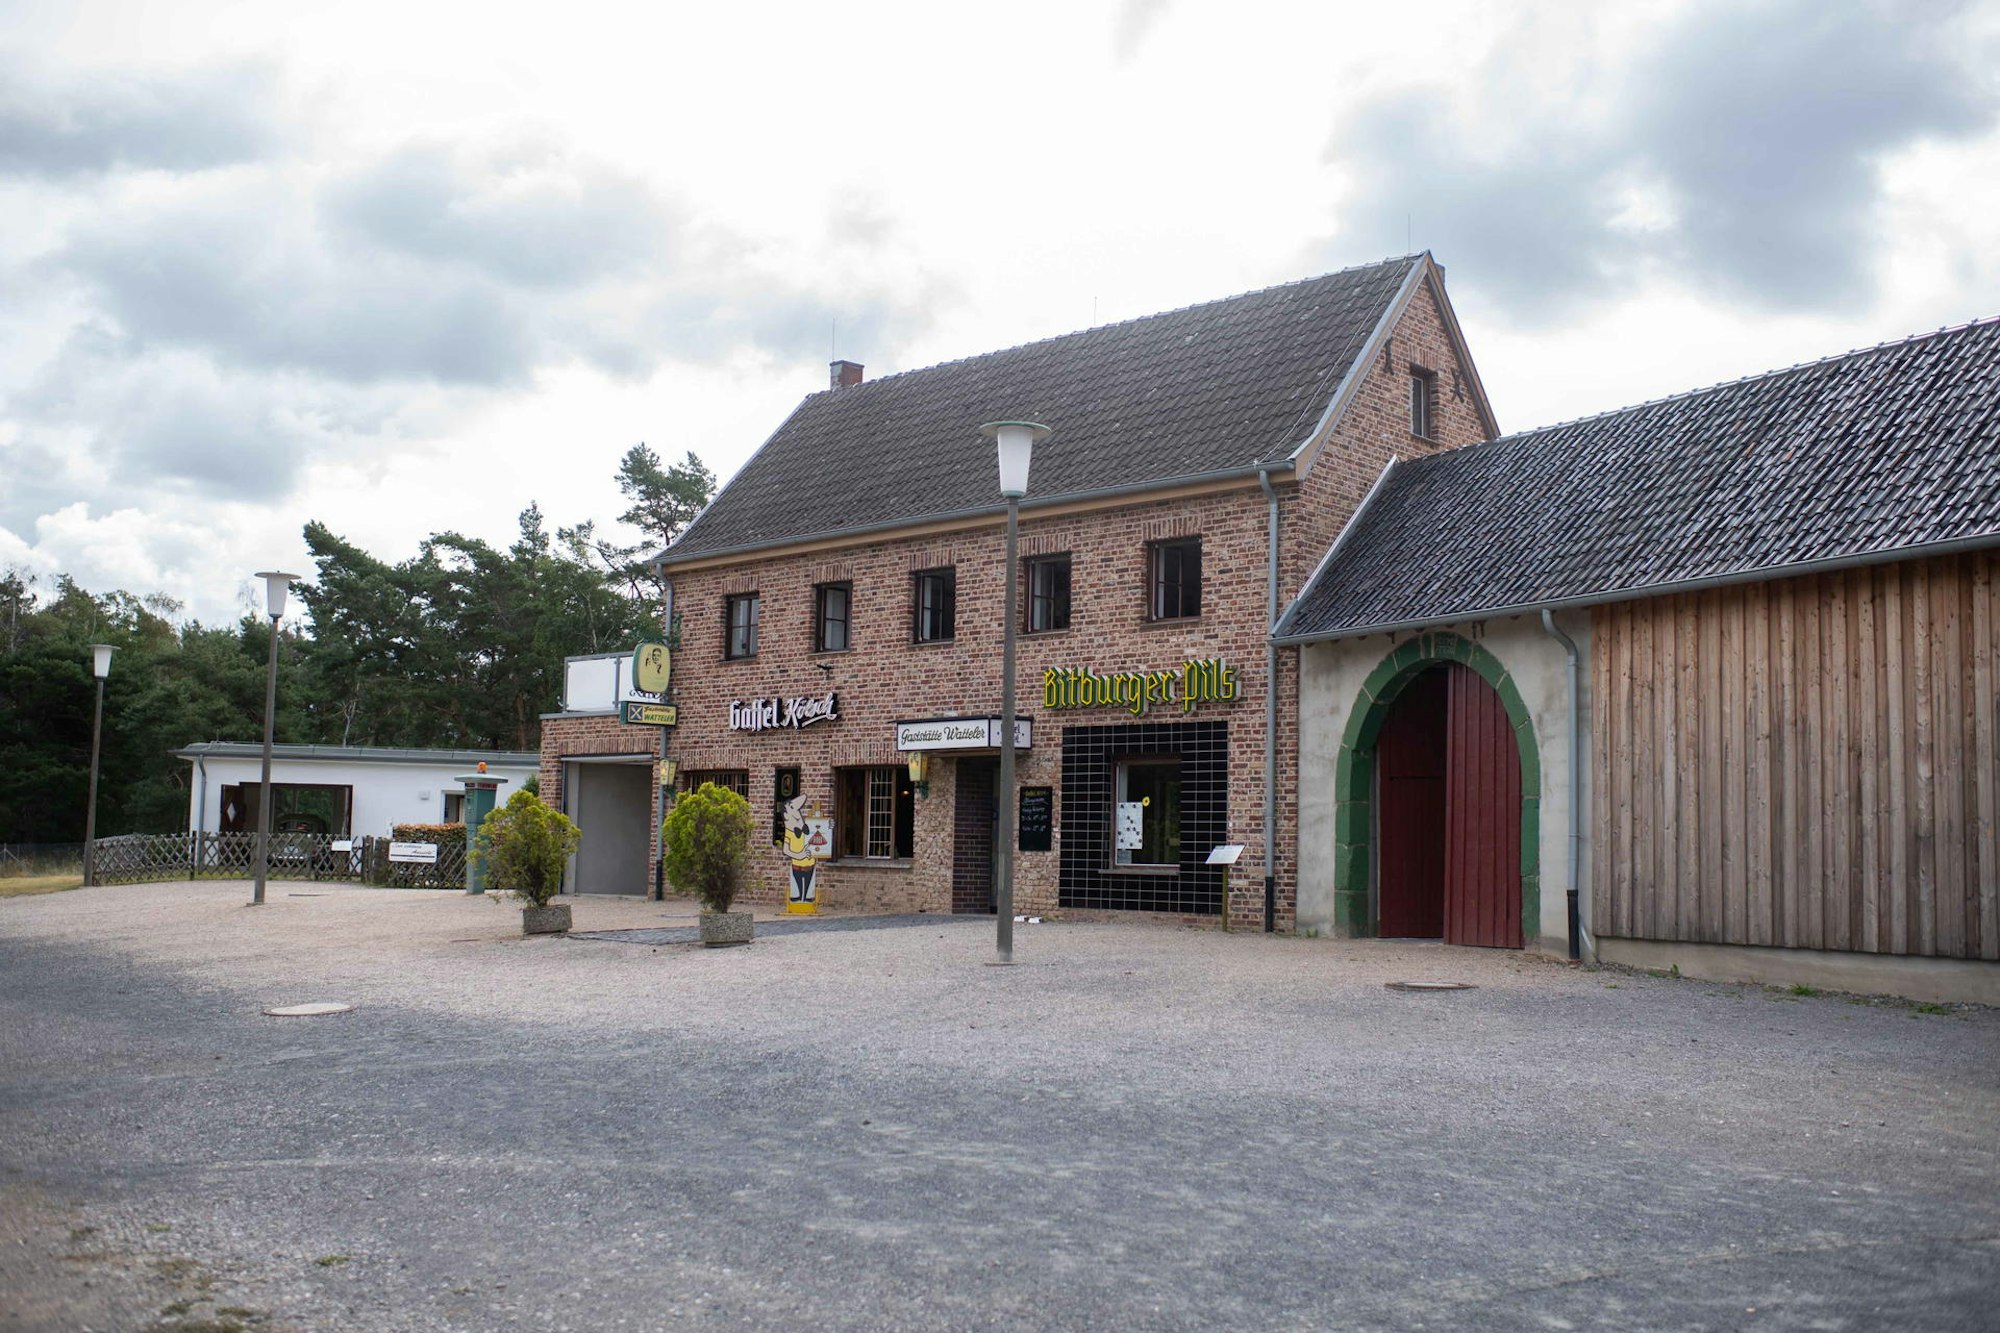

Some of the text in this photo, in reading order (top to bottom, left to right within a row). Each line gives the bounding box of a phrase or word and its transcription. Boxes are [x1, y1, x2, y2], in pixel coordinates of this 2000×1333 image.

[1044, 657, 1240, 716] Bitburger Pils
[730, 692, 838, 732] Gaffel Kölsch
[901, 728, 943, 745] Gaststätte
[943, 726, 985, 741] Watteler
